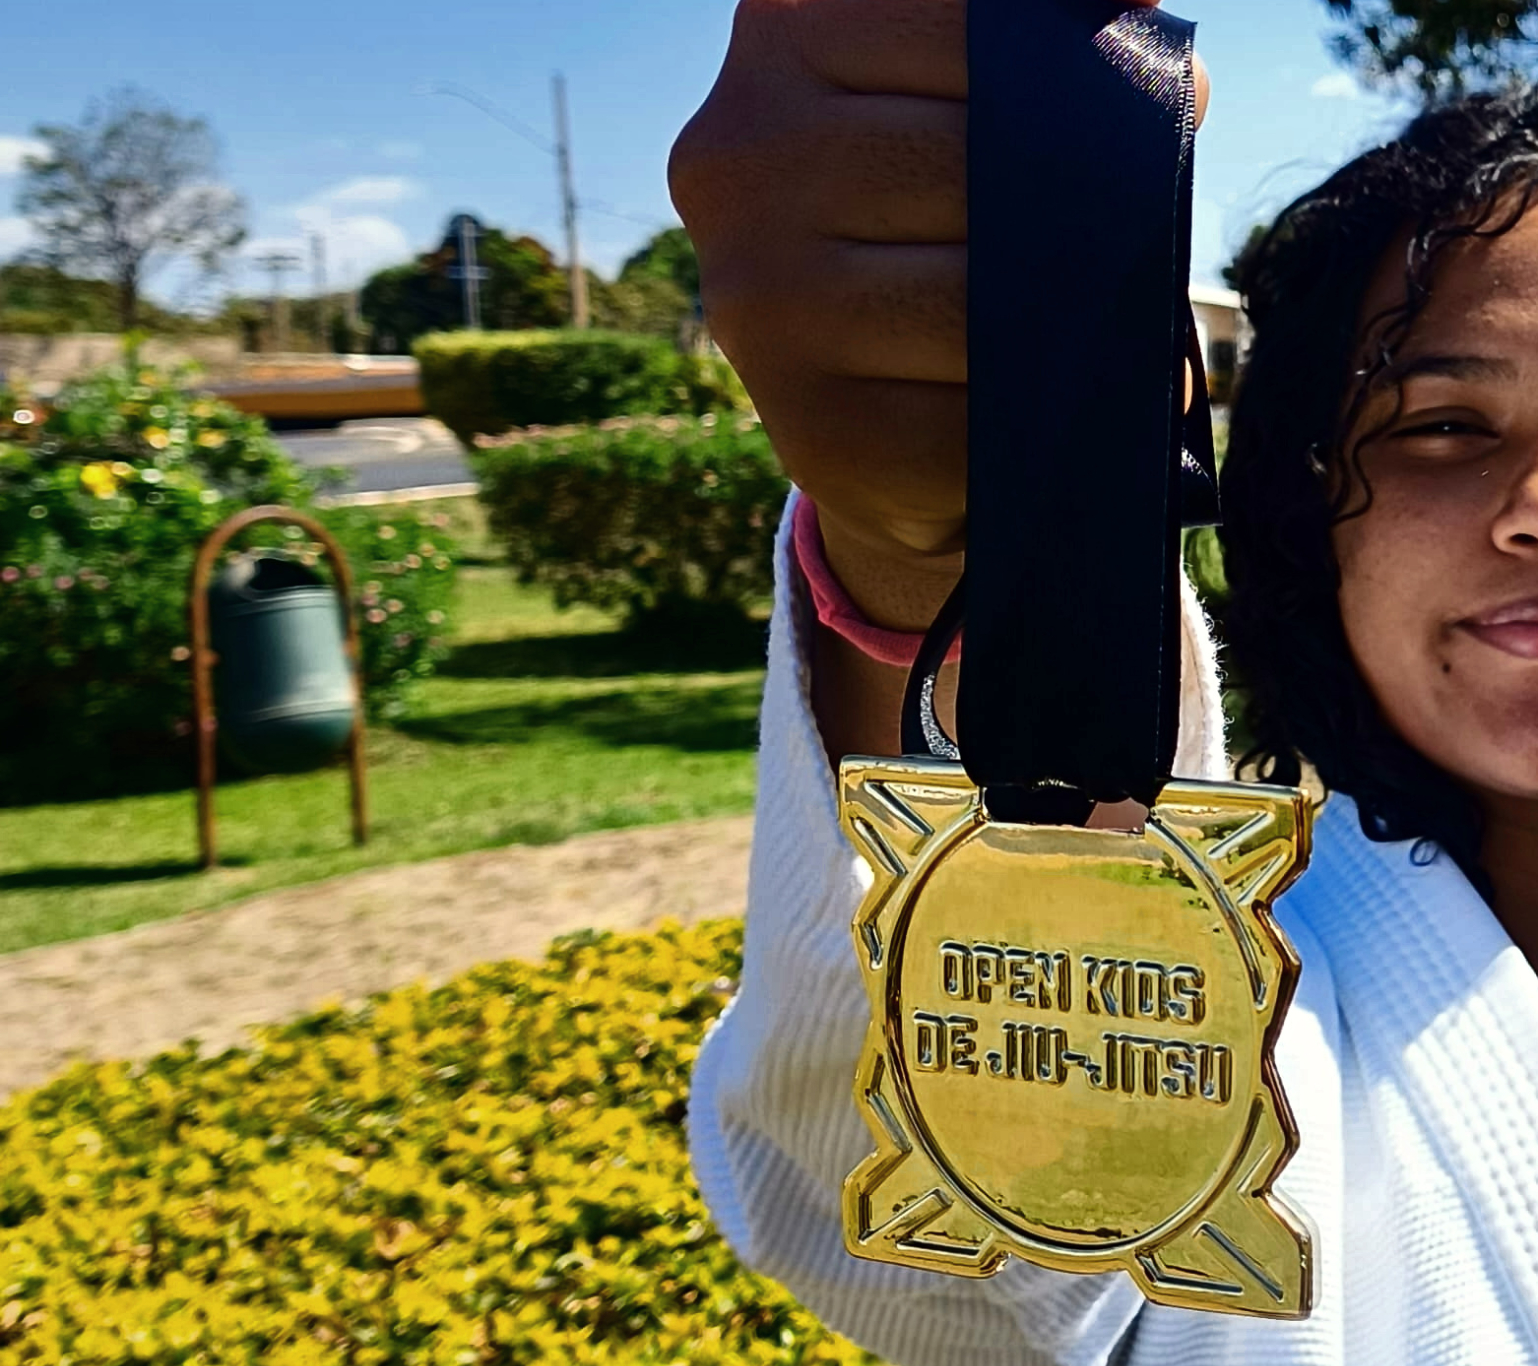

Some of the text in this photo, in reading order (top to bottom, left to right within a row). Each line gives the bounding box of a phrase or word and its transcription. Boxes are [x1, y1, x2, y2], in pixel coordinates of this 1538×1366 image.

[941, 941, 1206, 1025] OPEN KIDS
[913, 1011, 1233, 1105] DE JIU-JITSU
